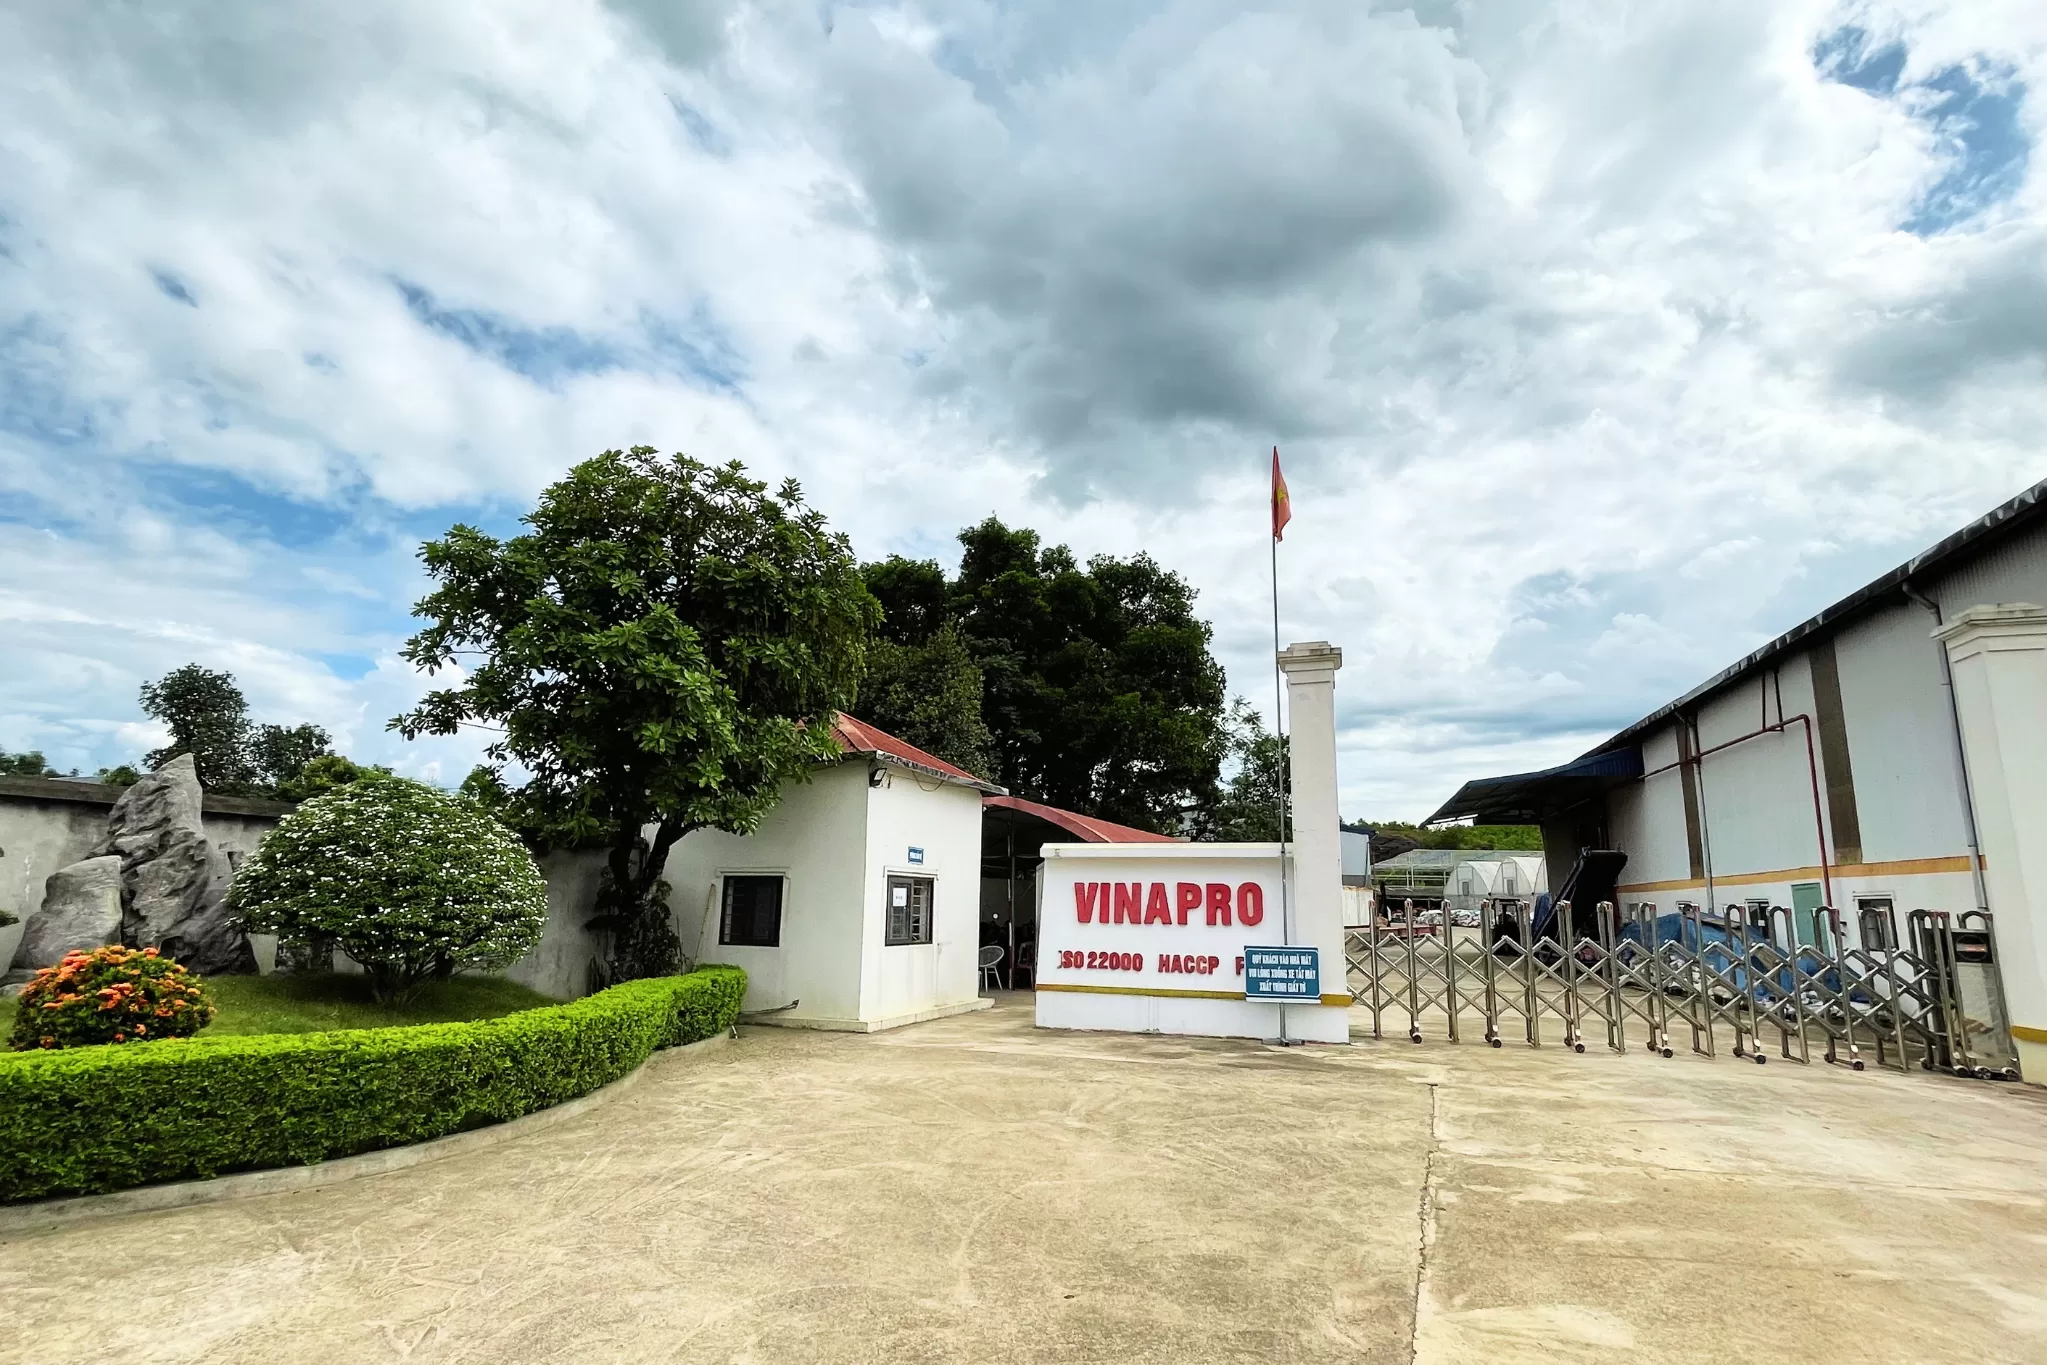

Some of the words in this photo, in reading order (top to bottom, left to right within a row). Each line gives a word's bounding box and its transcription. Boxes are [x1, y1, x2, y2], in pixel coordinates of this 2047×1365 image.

[1074, 882, 1264, 926] VINAPRO
[1087, 951, 1143, 972] 22000
[1157, 954, 1220, 975] HACCP
